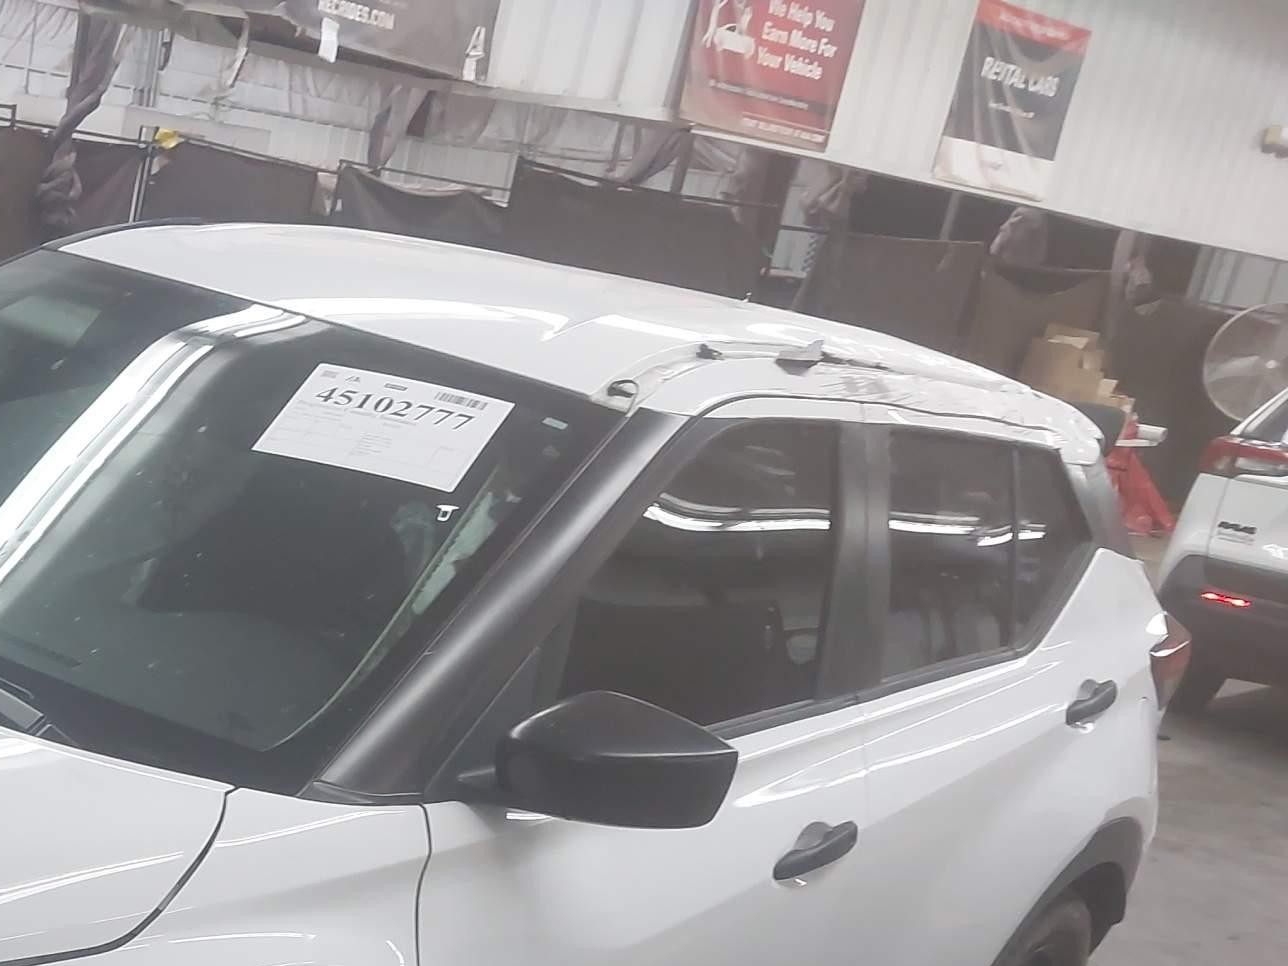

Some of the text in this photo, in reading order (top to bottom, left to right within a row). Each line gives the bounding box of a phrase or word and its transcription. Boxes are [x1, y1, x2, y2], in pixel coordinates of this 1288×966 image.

[787, 2, 813, 28] Help
[815, 10, 835, 32] You
[762, 21, 838, 58] Earn More For
[757, 46, 823, 80] Your Vehicle
[316, 387, 475, 430] 45102777
